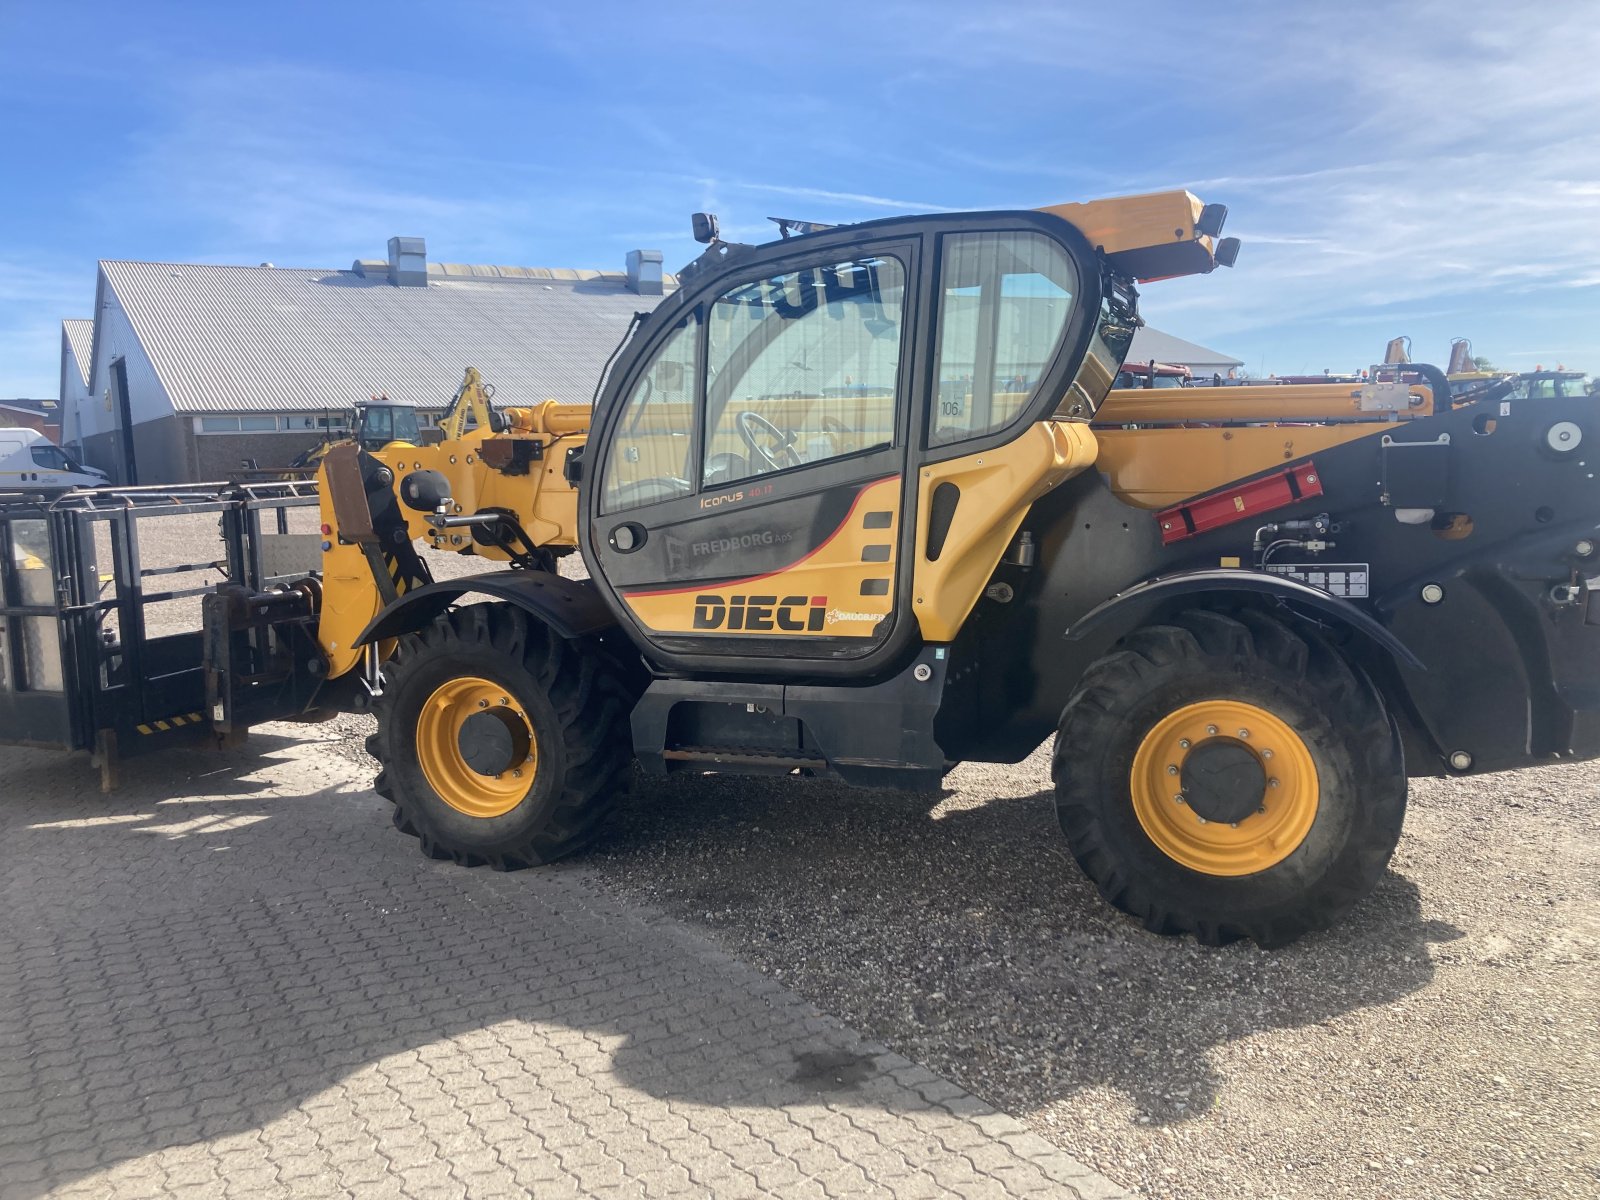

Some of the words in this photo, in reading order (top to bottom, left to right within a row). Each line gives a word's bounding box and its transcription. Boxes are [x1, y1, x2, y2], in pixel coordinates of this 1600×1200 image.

[942, 401, 959, 416] 106
[700, 491, 744, 509] Icarus
[692, 531, 773, 556] FREDBORG
[775, 531, 793, 544] ApS
